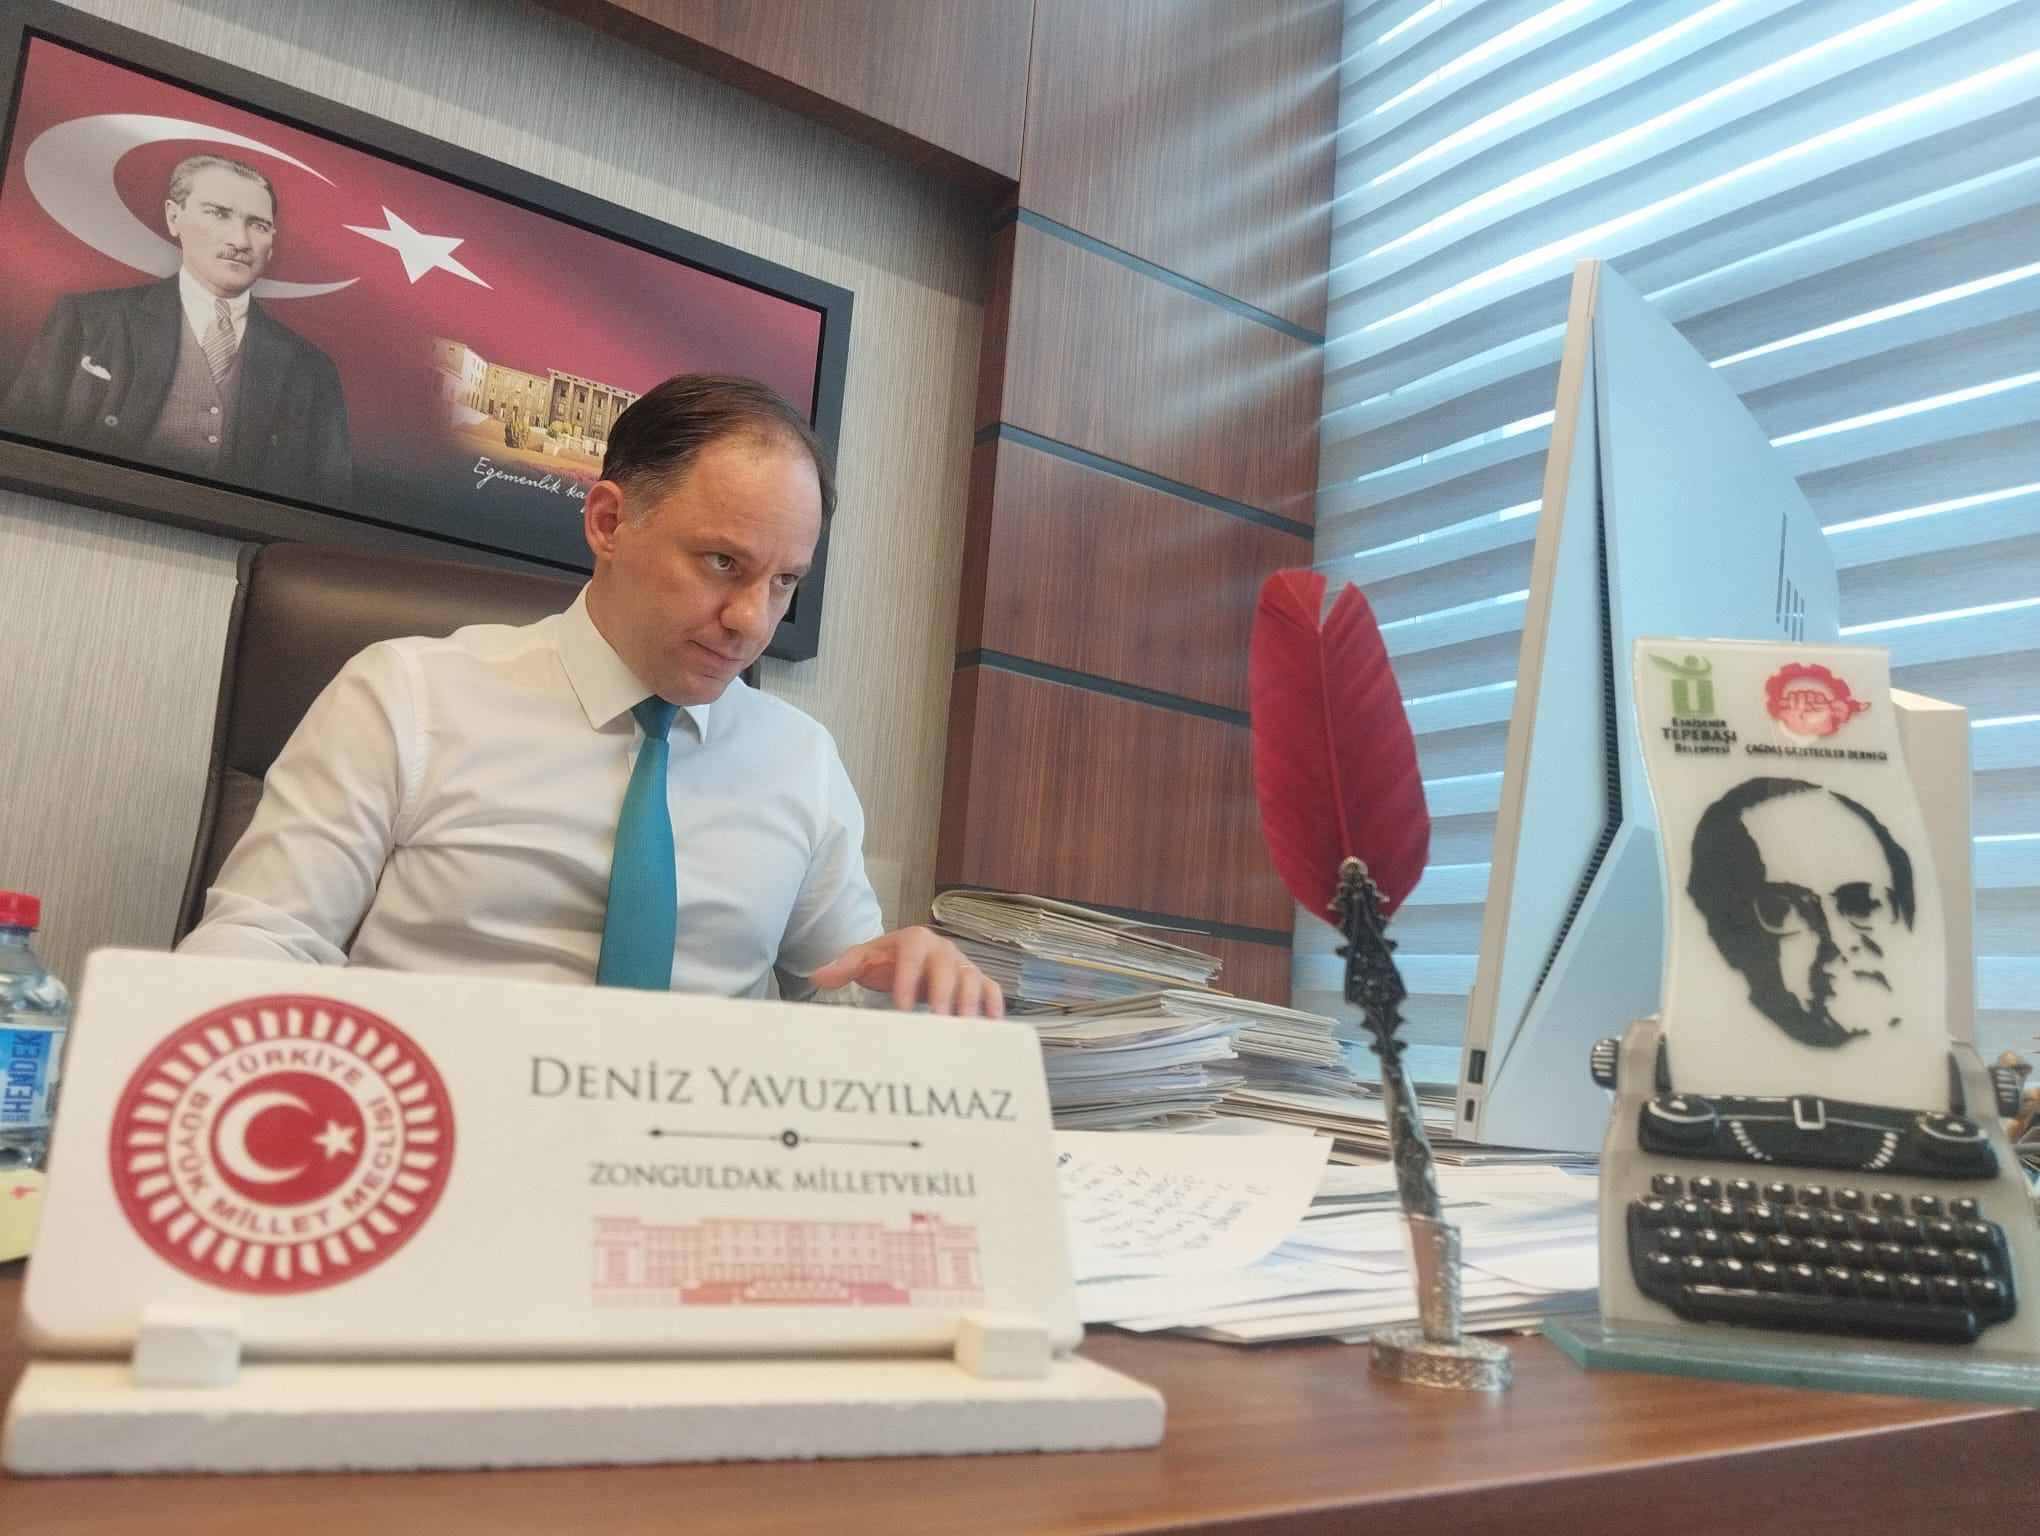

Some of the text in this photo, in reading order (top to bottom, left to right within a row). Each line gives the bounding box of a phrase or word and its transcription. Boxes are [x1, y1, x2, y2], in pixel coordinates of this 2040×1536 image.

[473, 456, 560, 490] Egemenlik
[1661, 727, 1737, 744] TEPEBAŞI
[3, 1033, 42, 1113] HENDEK
[217, 1048, 364, 1087] TÜRKİYE
[530, 1057, 1017, 1121] DENİZ YAVUZYILMAZ
[177, 1092, 211, 1194] BÜYÜK
[209, 1197, 331, 1236] MİLLET
[589, 1162, 782, 1190] ZONGULDAK
